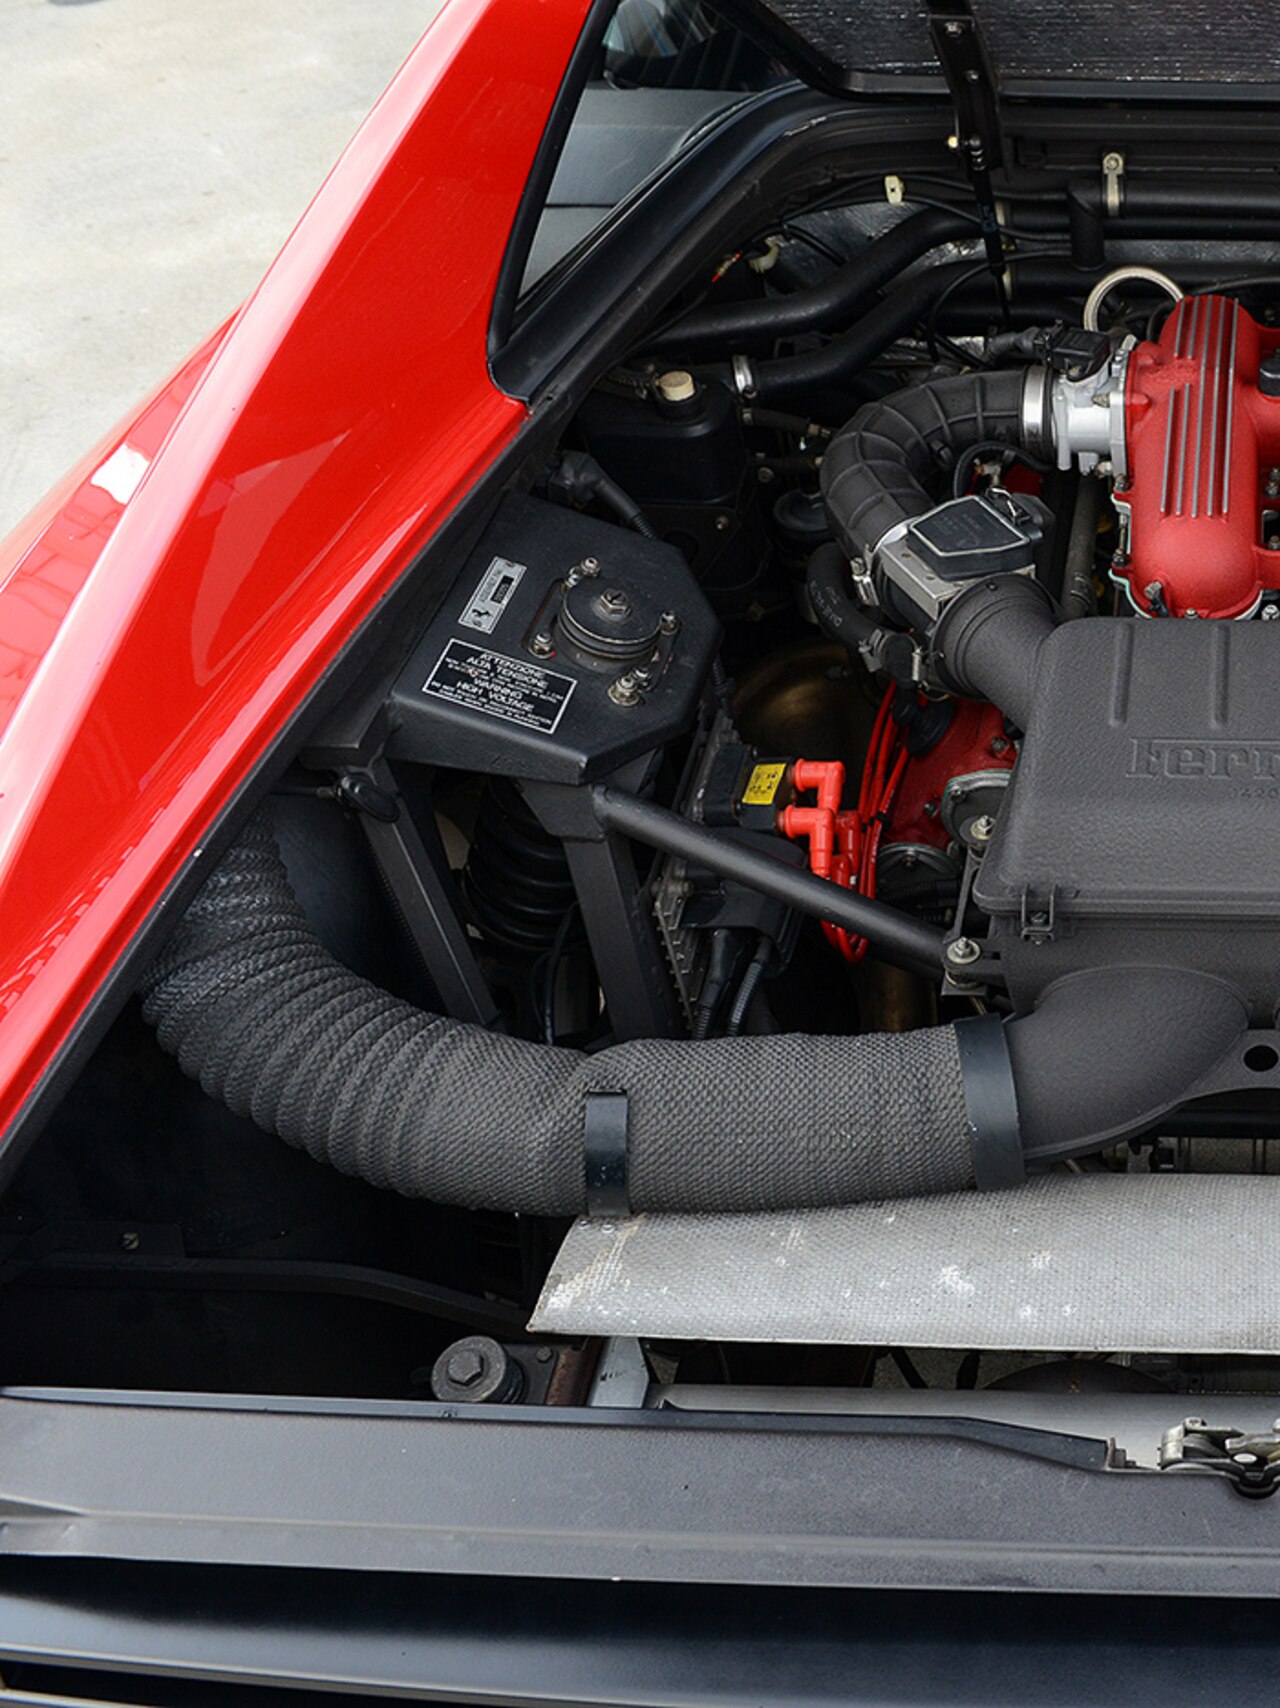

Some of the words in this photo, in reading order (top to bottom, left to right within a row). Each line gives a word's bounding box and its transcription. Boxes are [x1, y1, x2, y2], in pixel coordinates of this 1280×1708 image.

[465, 655, 493, 670] ALTA
[493, 665, 548, 689] TENSIONE
[478, 652, 545, 679] ATTENZIONE
[455, 680, 483, 694] HIGH
[486, 690, 534, 712] VOLTAGE
[471, 677, 523, 700] WARNING
